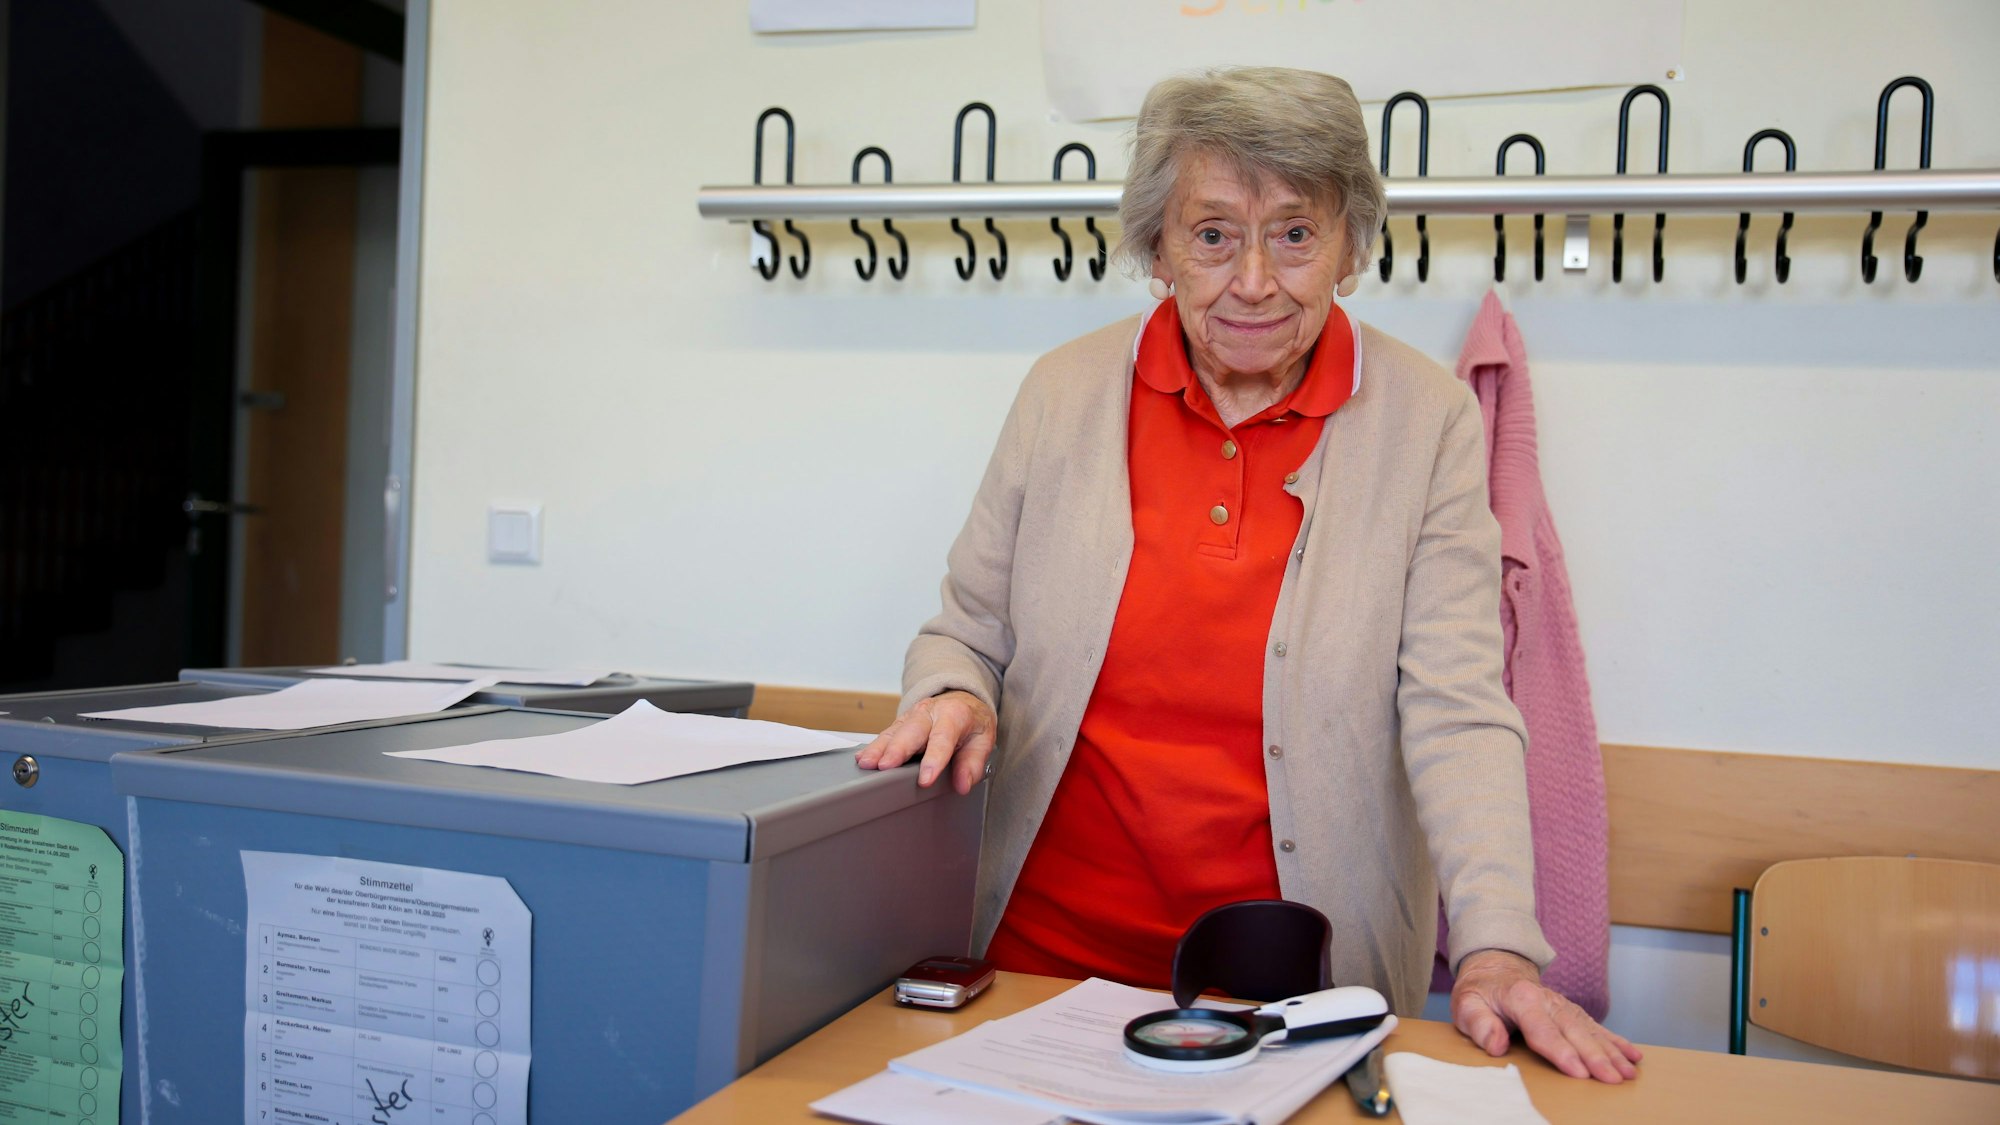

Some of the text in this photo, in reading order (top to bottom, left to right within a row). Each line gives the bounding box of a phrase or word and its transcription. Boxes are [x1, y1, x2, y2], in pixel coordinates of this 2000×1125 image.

[0, 822, 40, 835] Stimmzettel
[360, 876, 414, 892] Stimmzettel
[331, 887, 353, 896] des/der
[338, 898, 369, 908] kreisfreien
[371, 901, 386, 910] Stadt
[388, 903, 402, 913] Köln
[383, 918, 400, 926] einen
[265, 936, 268, 944] 1
[299, 934, 320, 942] Berivan
[263, 965, 268, 973] 2
[309, 966, 330, 974] Torsten
[263, 994, 268, 1003] 3
[312, 996, 332, 1004] Markus
[262, 1024, 267, 1032] 4
[261, 1052, 266, 1061] 5
[261, 1082, 266, 1090] 6
[261, 1111, 266, 1119] 7
[305, 1113, 329, 1122] Matthias
